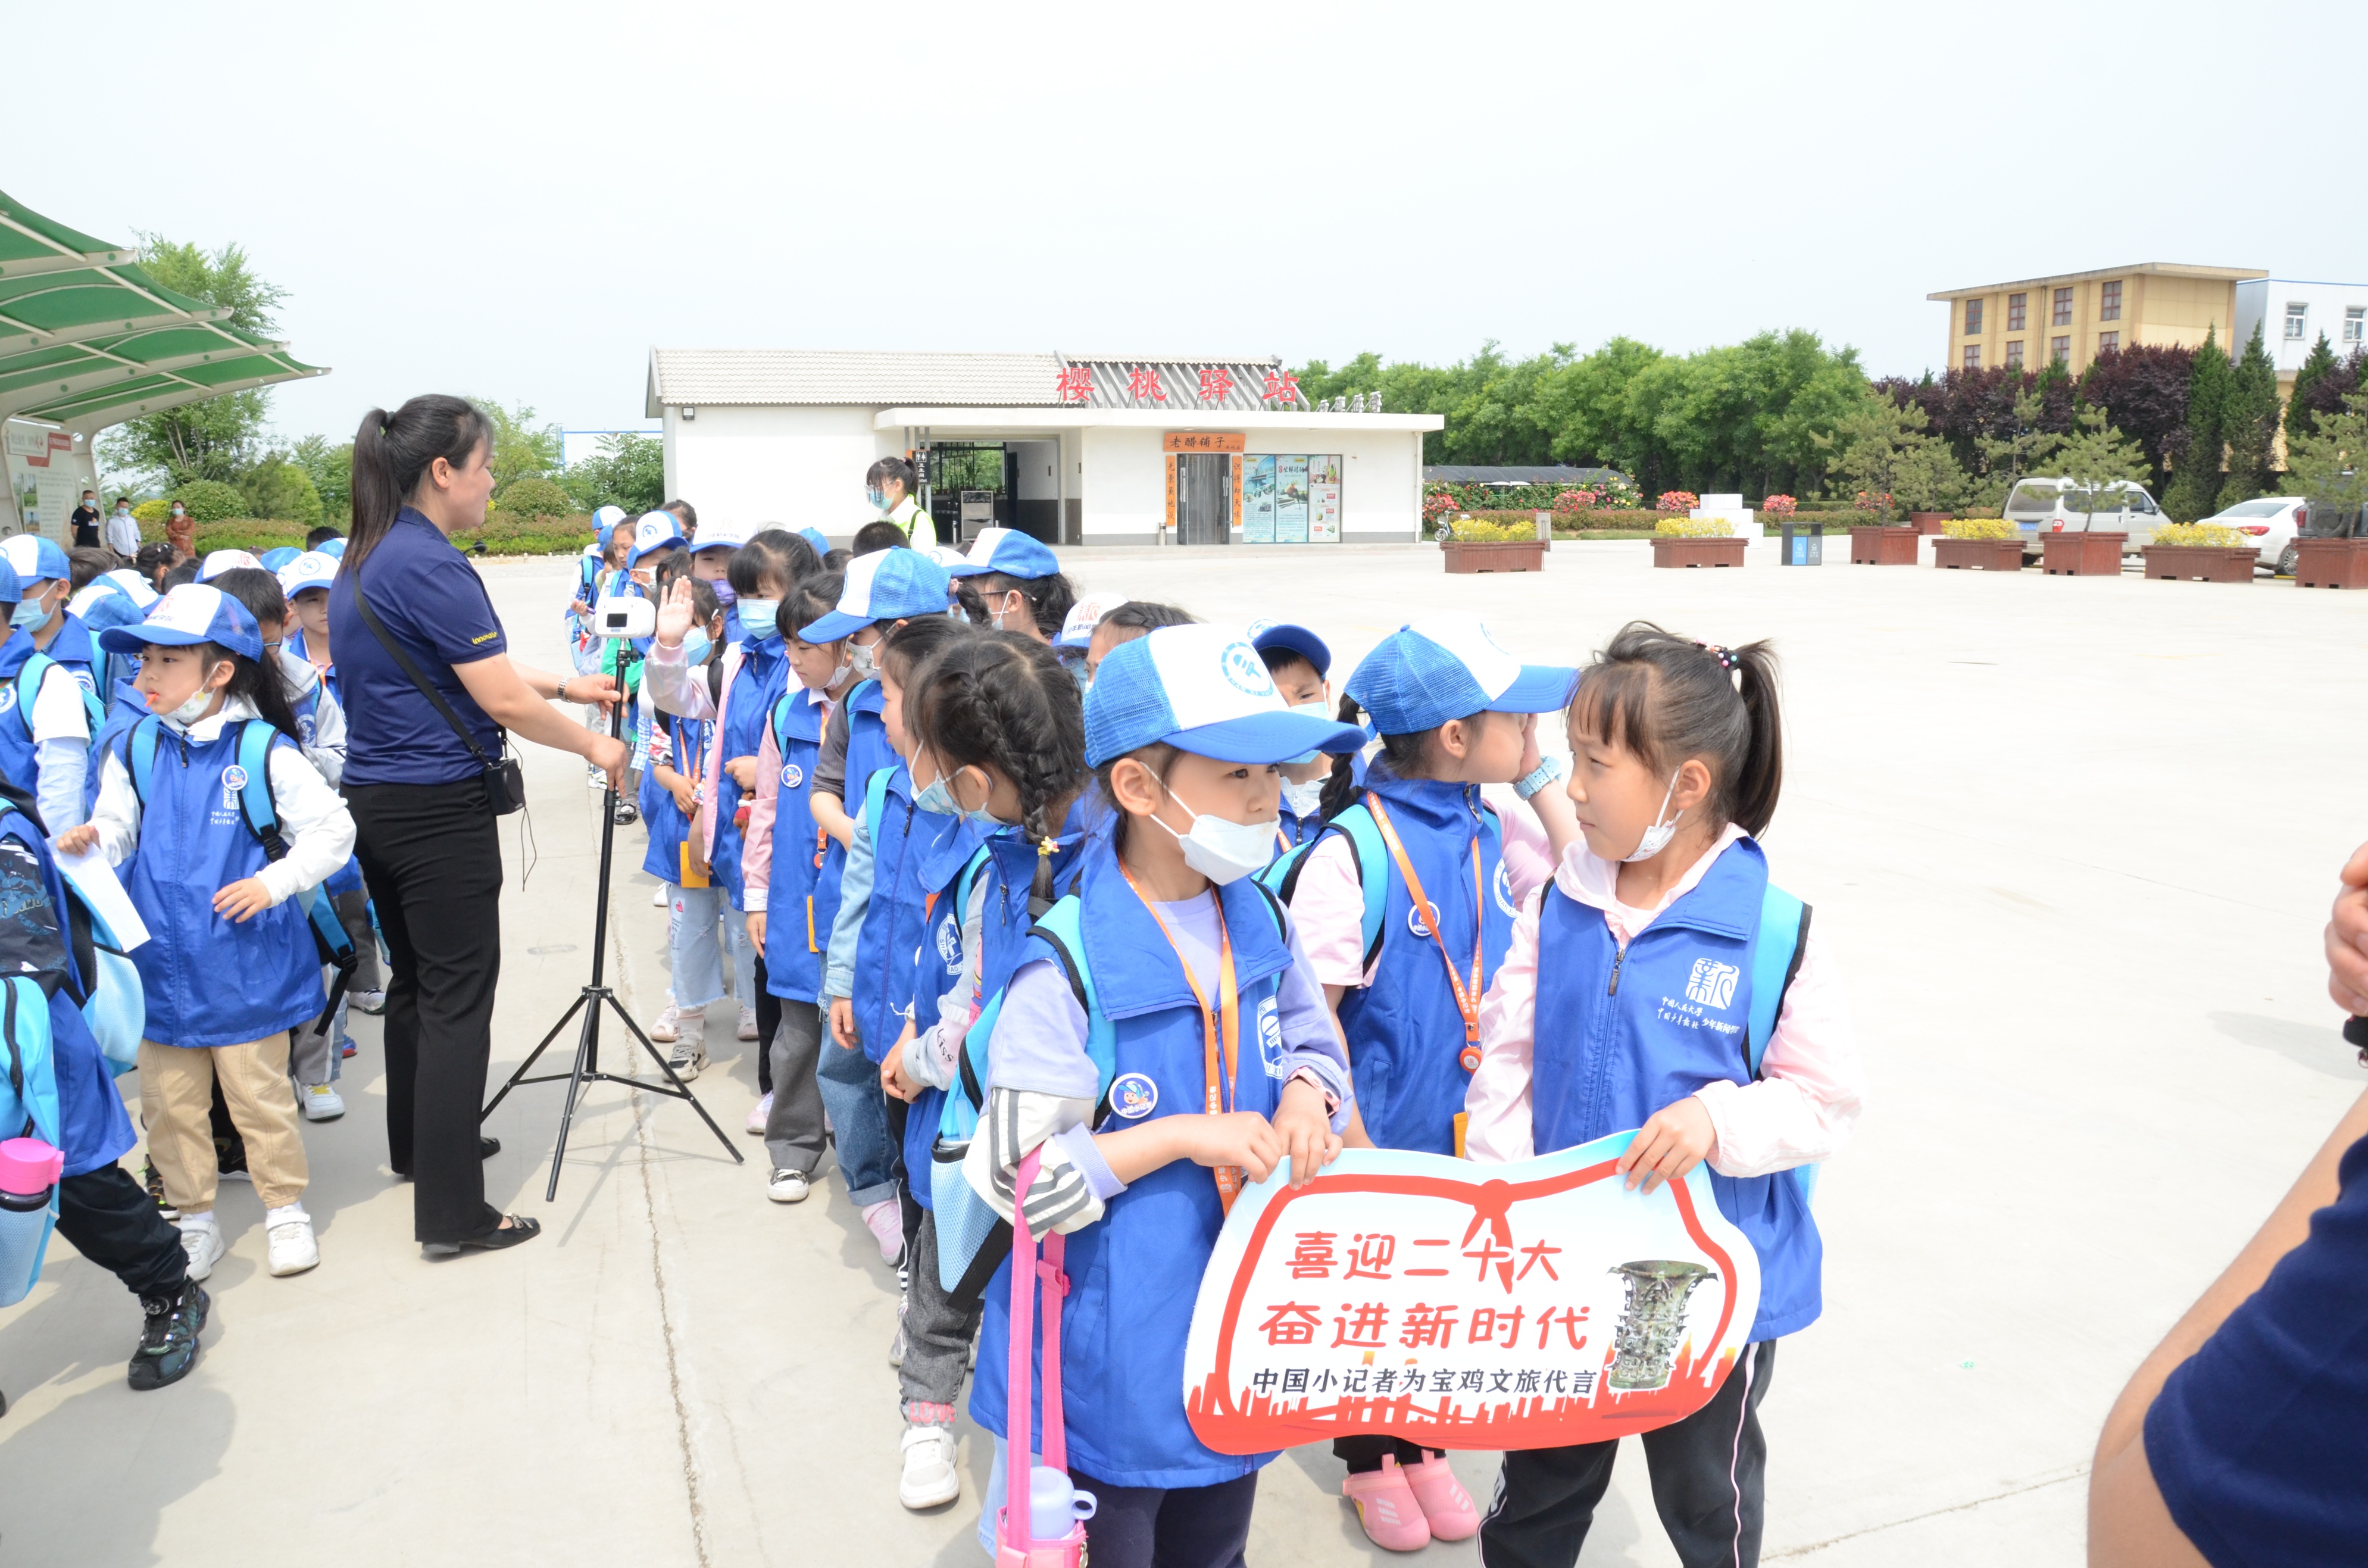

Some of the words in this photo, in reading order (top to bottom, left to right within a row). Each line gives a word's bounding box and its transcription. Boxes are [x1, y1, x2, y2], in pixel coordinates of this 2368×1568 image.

[1056, 367, 1299, 402] 樱桃驿站
[1170, 436, 1225, 448] 老醋铺子
[937, 1027, 954, 1062] kiss
[1285, 1230, 1563, 1282] 喜迎二十大
[1258, 1302, 1591, 1351] 奋进新时代
[1252, 1367, 1598, 1395] 中国小记者为宝鸡文旅代言
[909, 1401, 957, 1423] LOVE
